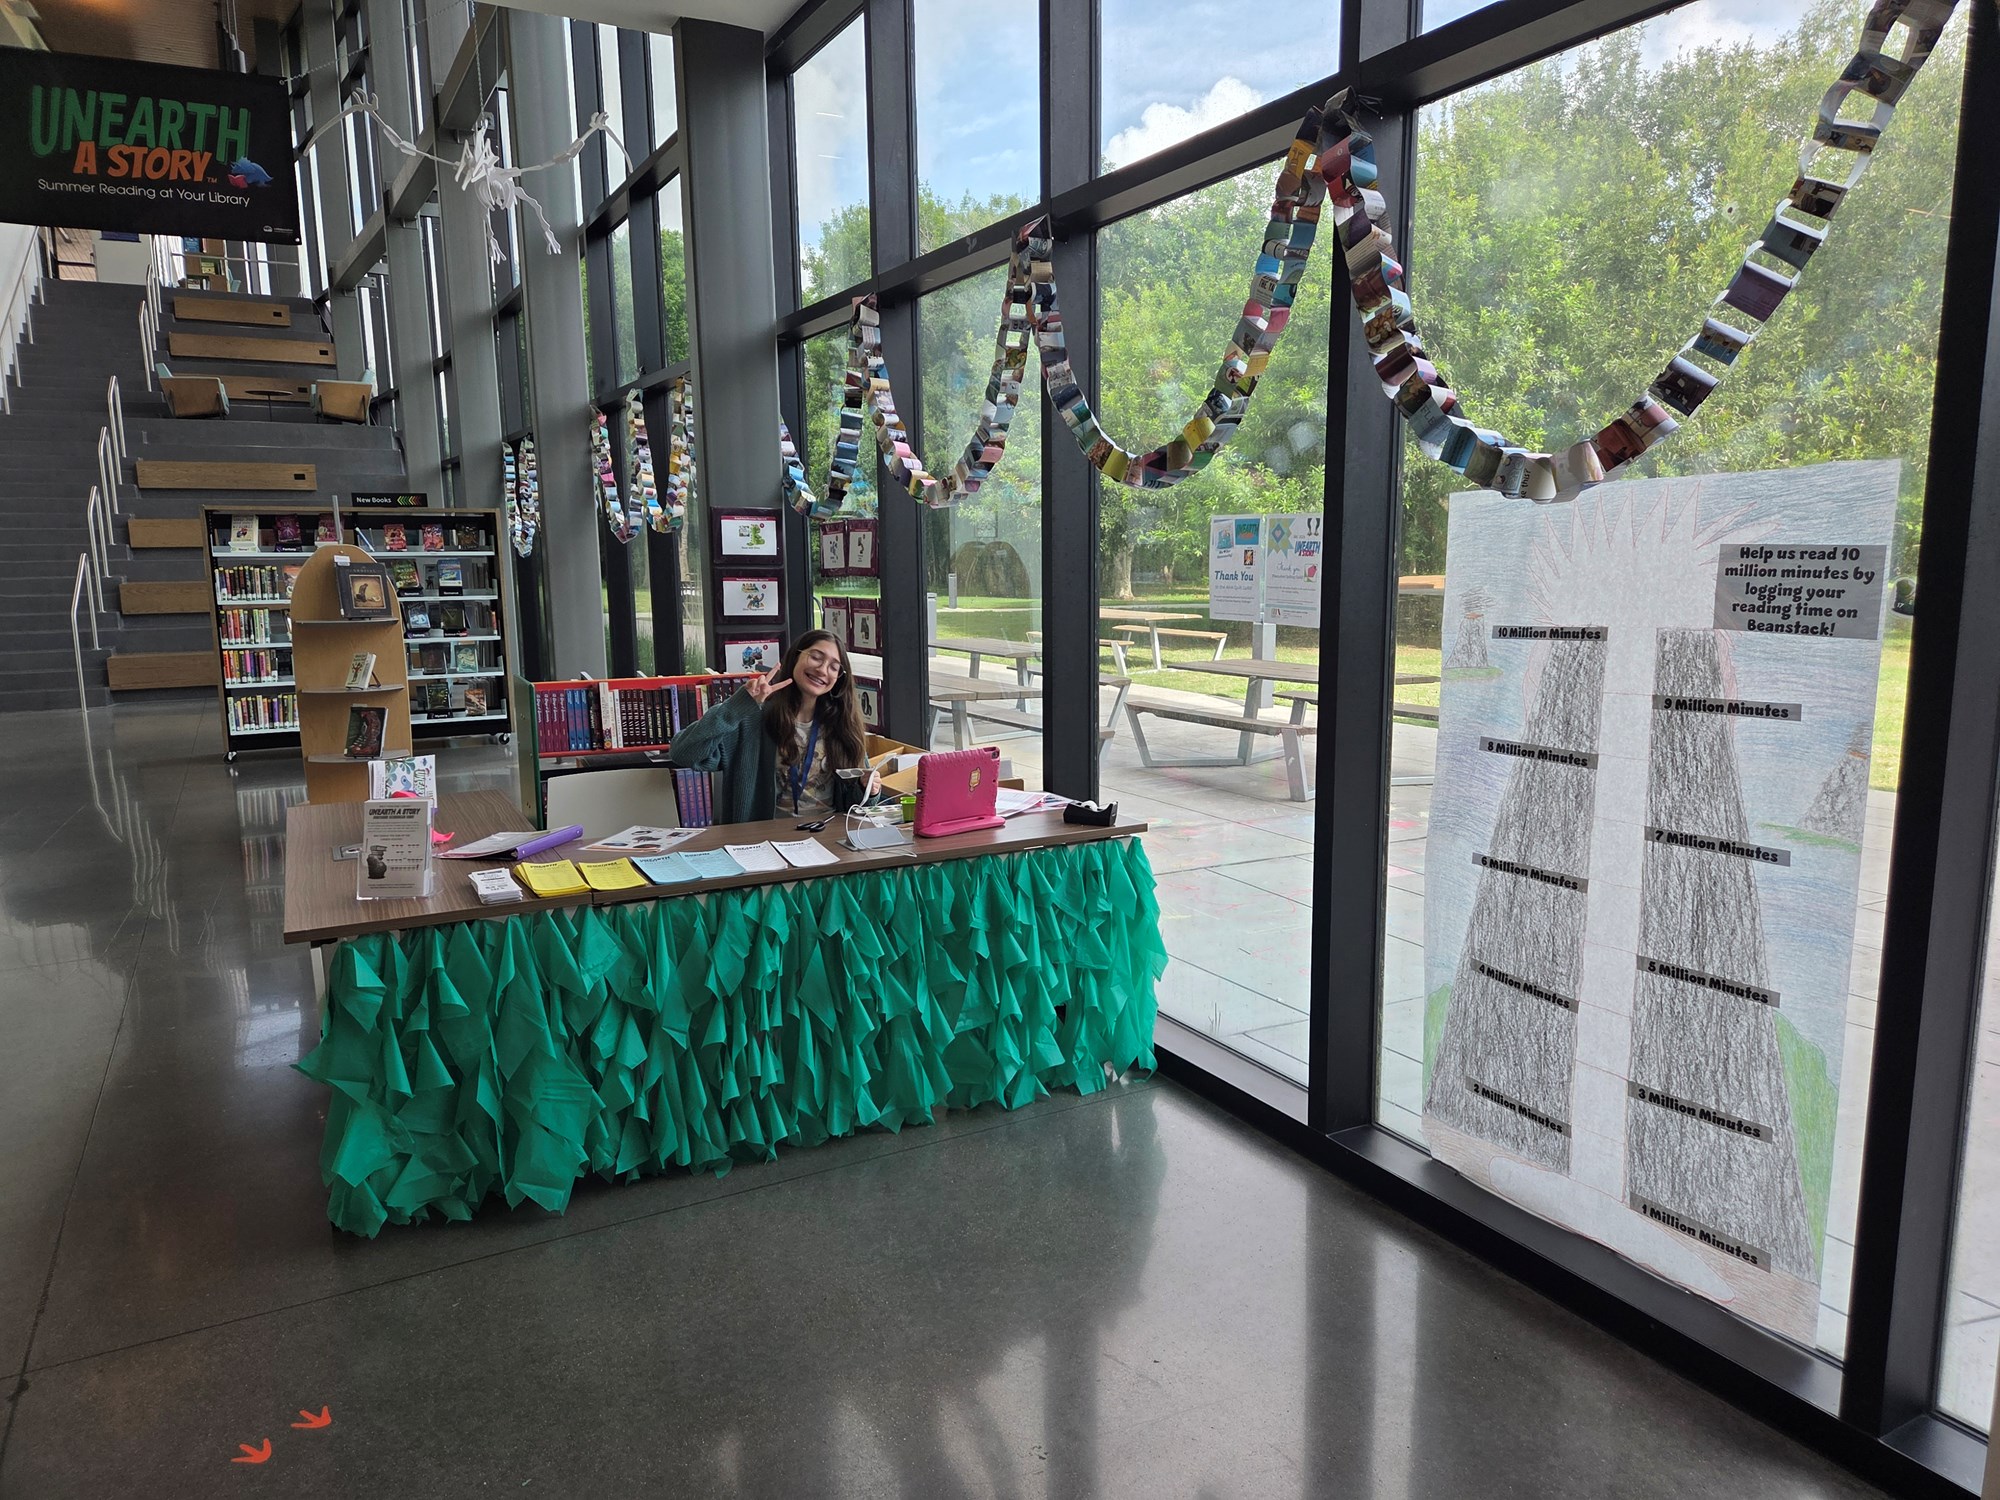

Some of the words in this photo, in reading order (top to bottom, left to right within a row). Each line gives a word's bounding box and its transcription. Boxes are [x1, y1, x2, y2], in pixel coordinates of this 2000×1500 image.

[31, 84, 251, 166] UNEARTH
[73, 141, 98, 175] A
[107, 143, 213, 182] STORY
[38, 178, 95, 193] Summer
[100, 183, 156, 200] Reading
[160, 188, 173, 198] at
[176, 188, 205, 201] Your
[209, 191, 250, 208] Library
[1740, 547, 1773, 563] Help
[1777, 550, 1796, 559] us
[1800, 547, 1837, 560] read
[1842, 548, 1860, 561] 10
[1214, 571, 1239, 581] Thank
[1240, 571, 1254, 581] You
[1725, 564, 1777, 577] million
[1781, 565, 1849, 580] minutes
[1853, 567, 1875, 585] by
[1745, 582, 1803, 602] logging
[1806, 587, 1846, 601] your
[1732, 601, 1792, 620] reading
[1796, 602, 1833, 618] time
[1837, 608, 1858, 618] on
[1498, 627, 1507, 637] 10
[1509, 627, 1547, 638] Million
[1549, 628, 1601, 640] Minutes
[1747, 619, 1836, 637] Beanstack!
[1664, 698, 1672, 709] 9
[1675, 699, 1724, 713] Million
[1727, 702, 1789, 718] Minutes
[1488, 742, 1494, 751] 8
[1496, 743, 1535, 758] Million
[1537, 750, 1588, 766] Minutes
[1655, 830, 1664, 841] 7
[1667, 832, 1715, 850] Million
[1719, 841, 1778, 862] Minutes
[1481, 856, 1487, 866] 6
[1490, 858, 1528, 876] Million
[1530, 868, 1578, 890] Minutes
[1479, 964, 1485, 974] 4
[1486, 967, 1521, 989] Million
[1523, 982, 1570, 1009] Minutes
[1648, 961, 1656, 972] 5
[1659, 964, 1706, 985] Million
[1709, 977, 1768, 1004] Minutes
[1474, 1083, 1480, 1093] 2
[1481, 1087, 1516, 1111] Million
[1518, 1104, 1563, 1133] Minutes
[1638, 1088, 1646, 1099] 3
[1648, 1092, 1696, 1116] Million
[1699, 1108, 1760, 1138] Minutes
[1642, 1204, 1647, 1214] 1
[1649, 1207, 1696, 1236] Million
[1699, 1229, 1758, 1265] Minutes
